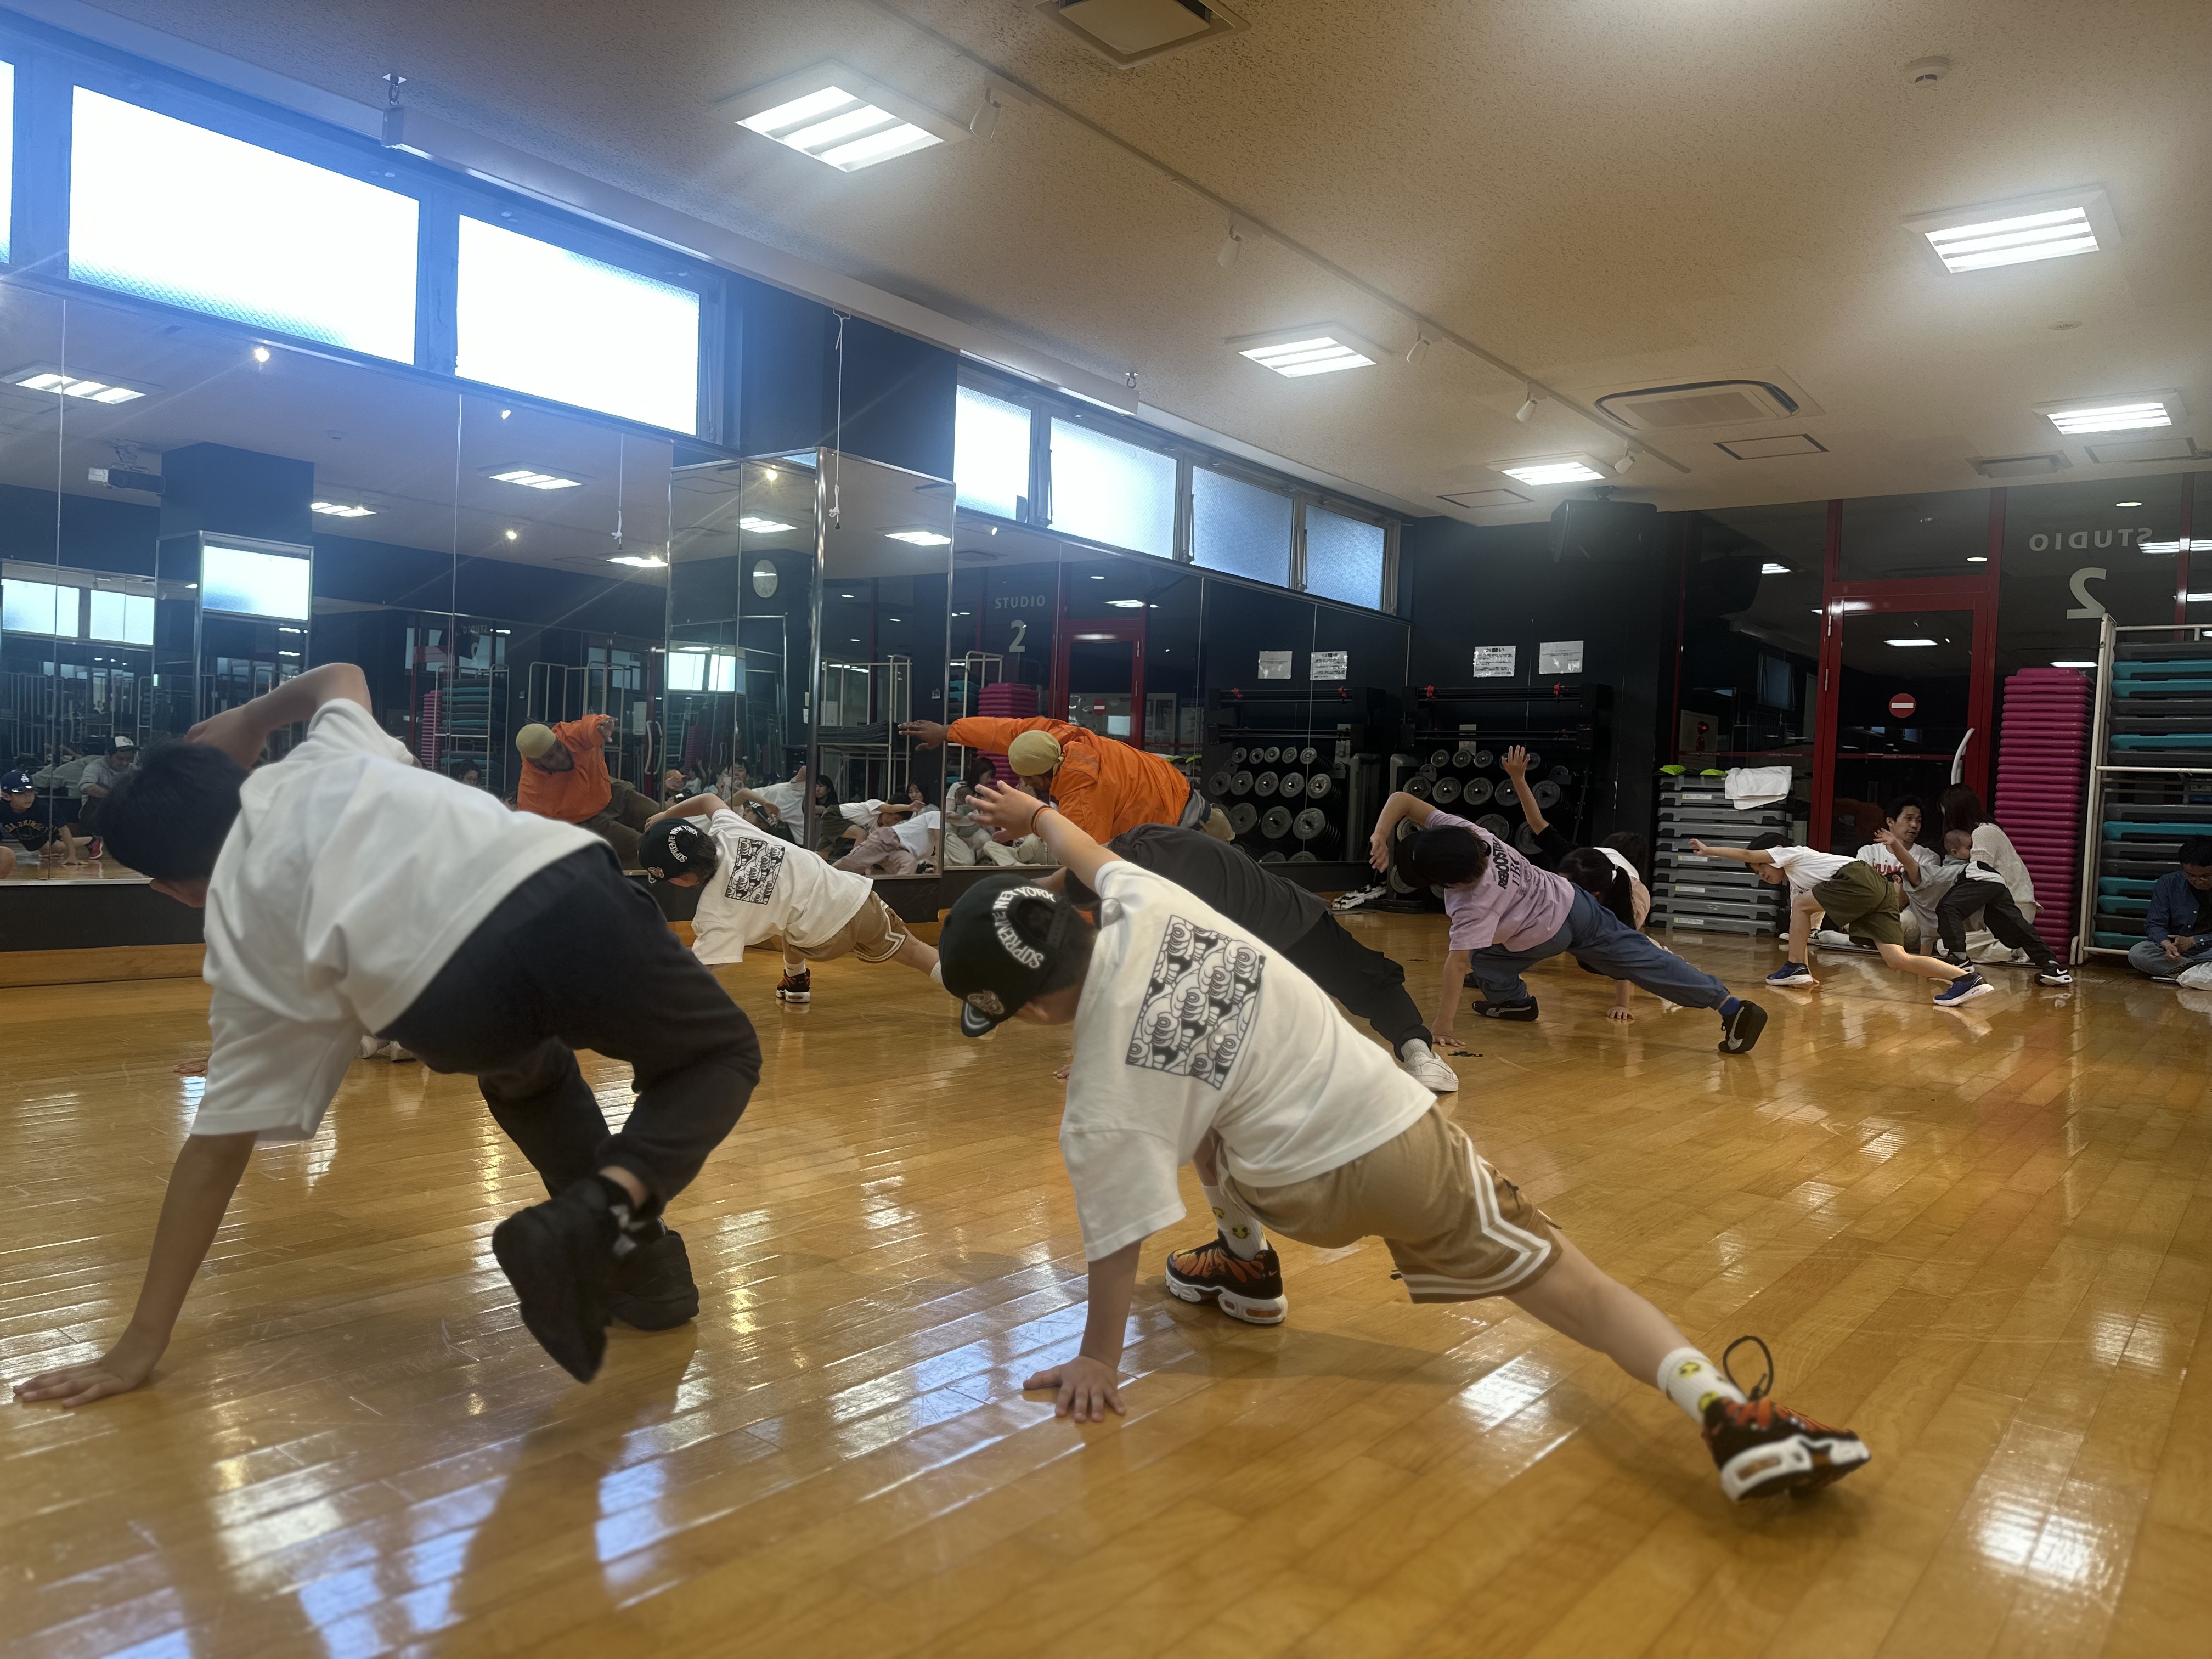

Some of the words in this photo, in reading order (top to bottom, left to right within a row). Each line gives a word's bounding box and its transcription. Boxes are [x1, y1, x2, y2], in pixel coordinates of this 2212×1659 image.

[995, 595, 1046, 609] STUDIO
[1009, 620, 1026, 652] 2
[670, 826, 684, 835] NEW
[681, 825, 698, 837] YORK
[668, 834, 687, 863] SUPREME
[993, 890, 1020, 910] NEW
[1014, 886, 1056, 902] YORK
[992, 911, 1044, 968] SUPREME
